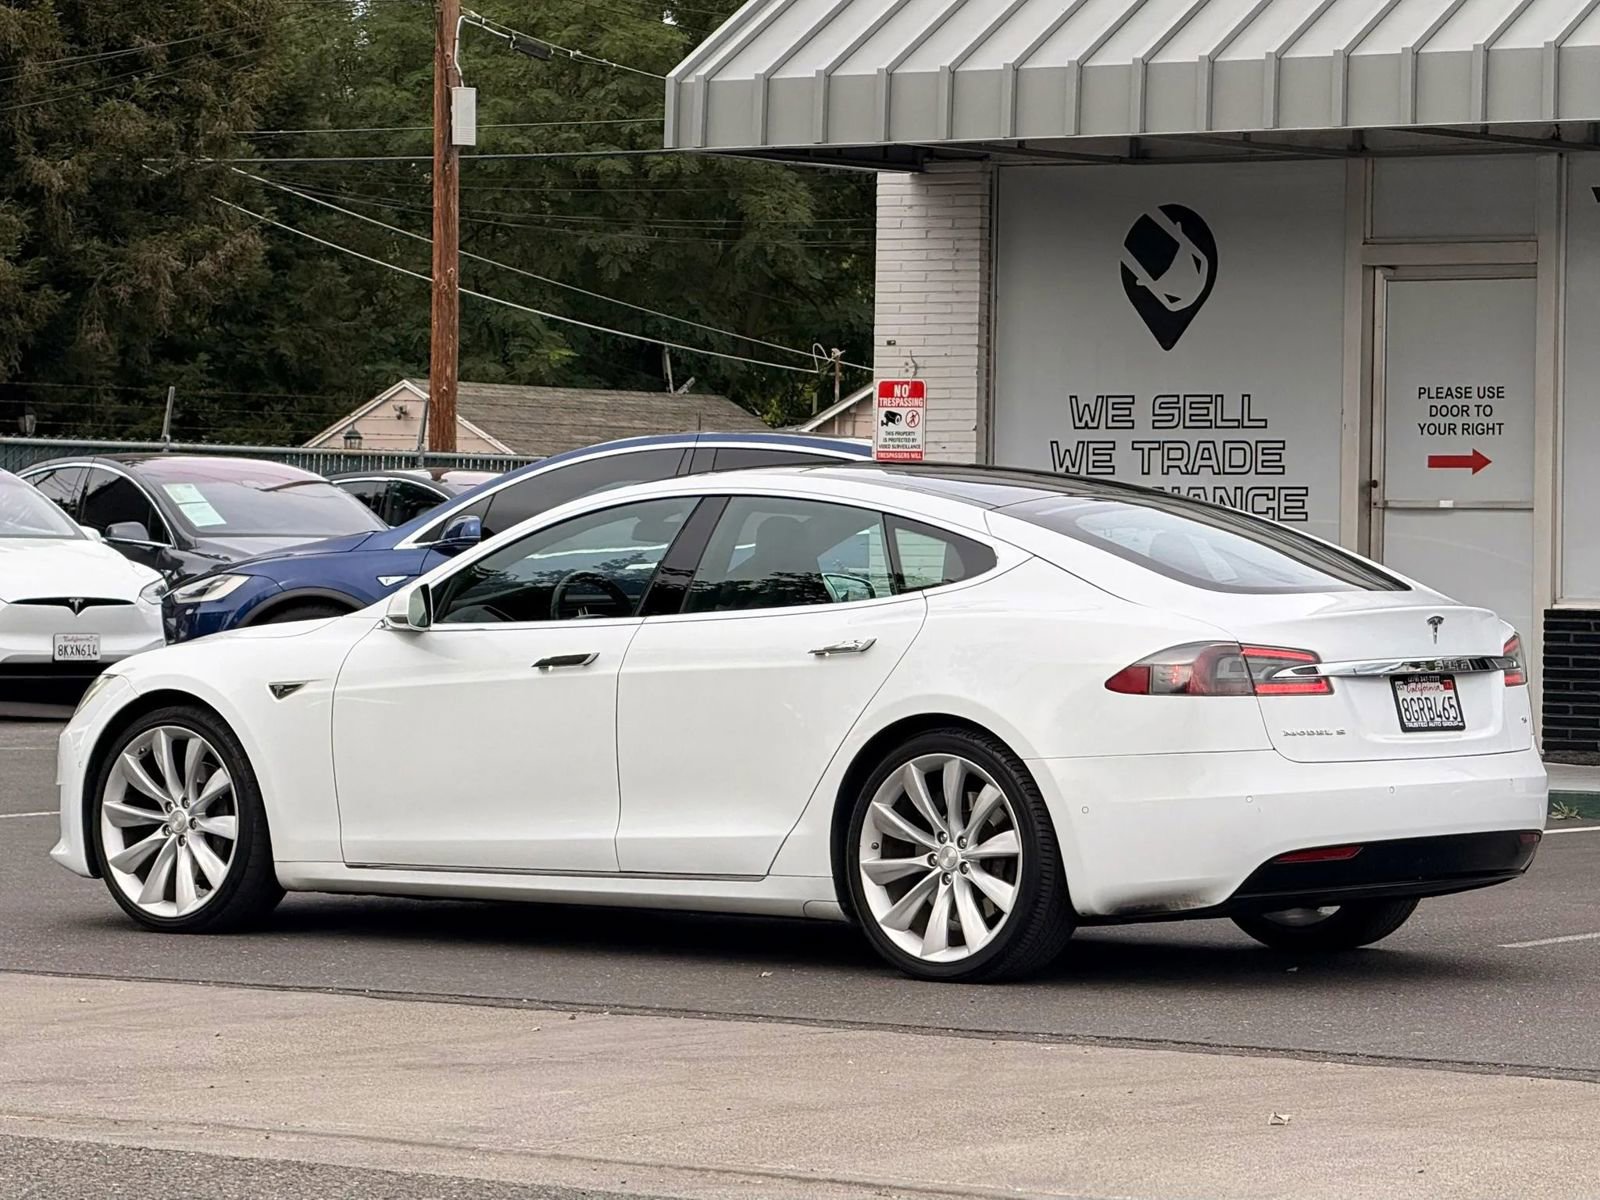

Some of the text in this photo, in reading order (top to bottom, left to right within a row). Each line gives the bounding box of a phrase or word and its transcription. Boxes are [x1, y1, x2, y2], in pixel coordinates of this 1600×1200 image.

[893, 384, 909, 398] NO
[1418, 386, 1505, 400] PLEASE USE
[879, 397, 924, 407] TRESPASSING
[1069, 394, 1268, 429] WE SELL
[1429, 404, 1493, 417] DOOR TO
[1417, 422, 1505, 436] YOUR RIGHT
[1050, 440, 1286, 475] WE TRADE
[57, 644, 98, 657] 8KXN614
[1406, 681, 1442, 696] California
[1401, 696, 1459, 722] 8GRB465
[1282, 729, 1333, 737] MODEL
